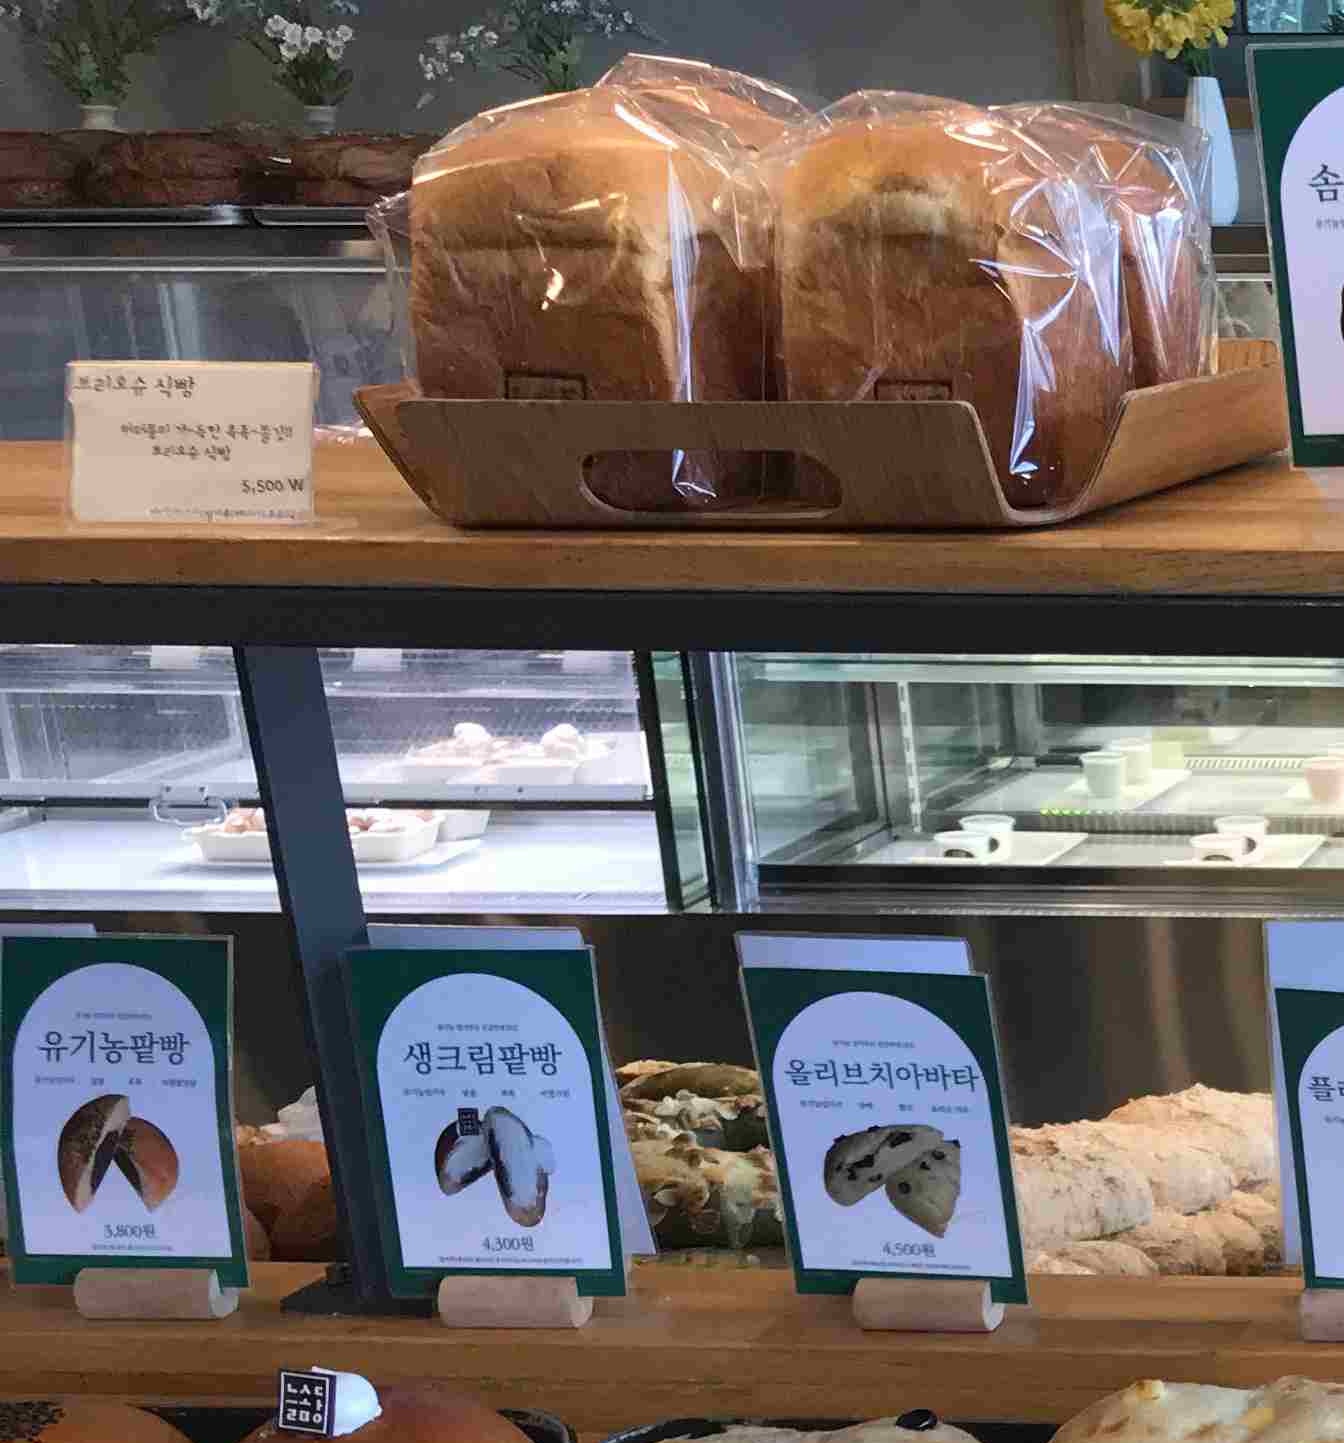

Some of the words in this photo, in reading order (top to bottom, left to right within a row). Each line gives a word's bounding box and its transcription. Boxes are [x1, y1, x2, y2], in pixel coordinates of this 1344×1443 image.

[154, 374, 197, 399] 식빵
[241, 479, 284, 494] 5,500
[288, 479, 304, 492] W
[37, 1030, 192, 1065] 유기농팥빵
[403, 1041, 563, 1077] 생크림팥빵
[784, 1059, 980, 1093] 올리브치아바타
